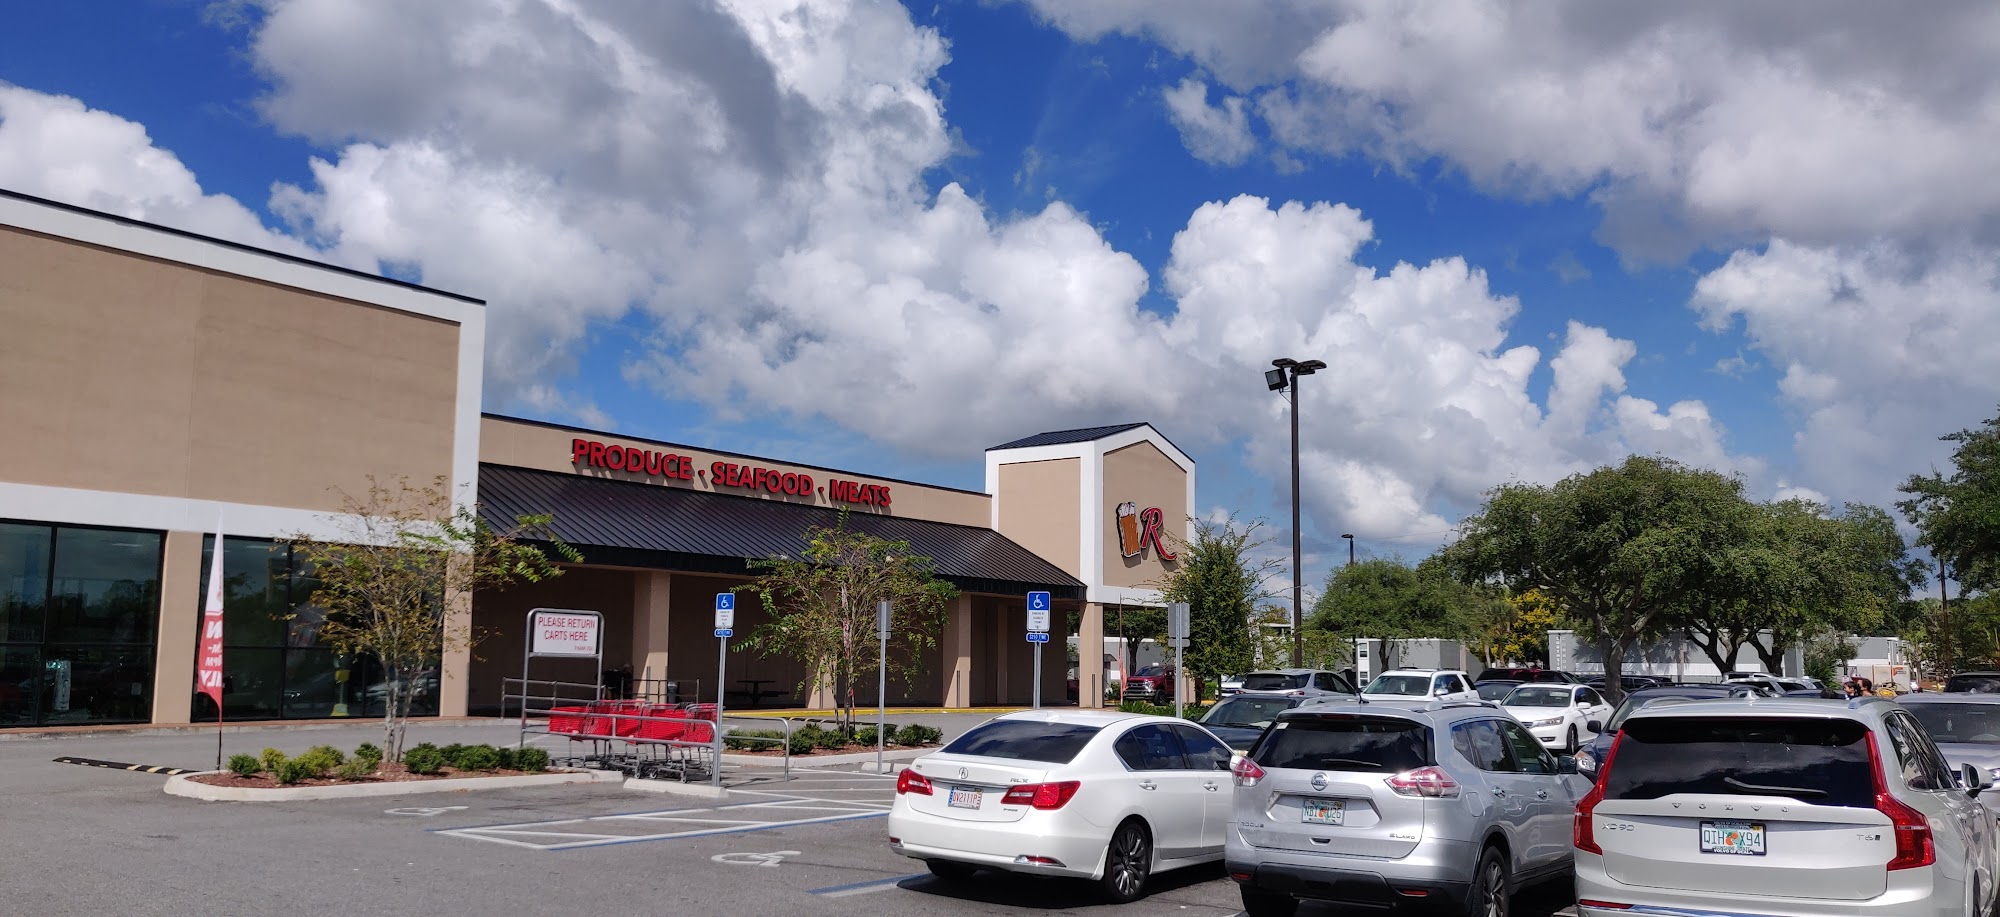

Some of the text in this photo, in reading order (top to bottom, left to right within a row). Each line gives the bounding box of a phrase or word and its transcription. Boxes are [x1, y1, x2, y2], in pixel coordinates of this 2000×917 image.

[572, 438, 892, 507] PRODUCE SEAFOOD MEATS
[1140, 507, 1177, 561] R
[538, 617, 595, 628] PLEASE RETURN
[545, 630, 588, 641] CARTS HERE
[1672, 802, 1789, 813] VOLVO
[1704, 830, 1760, 846] QIH X94
